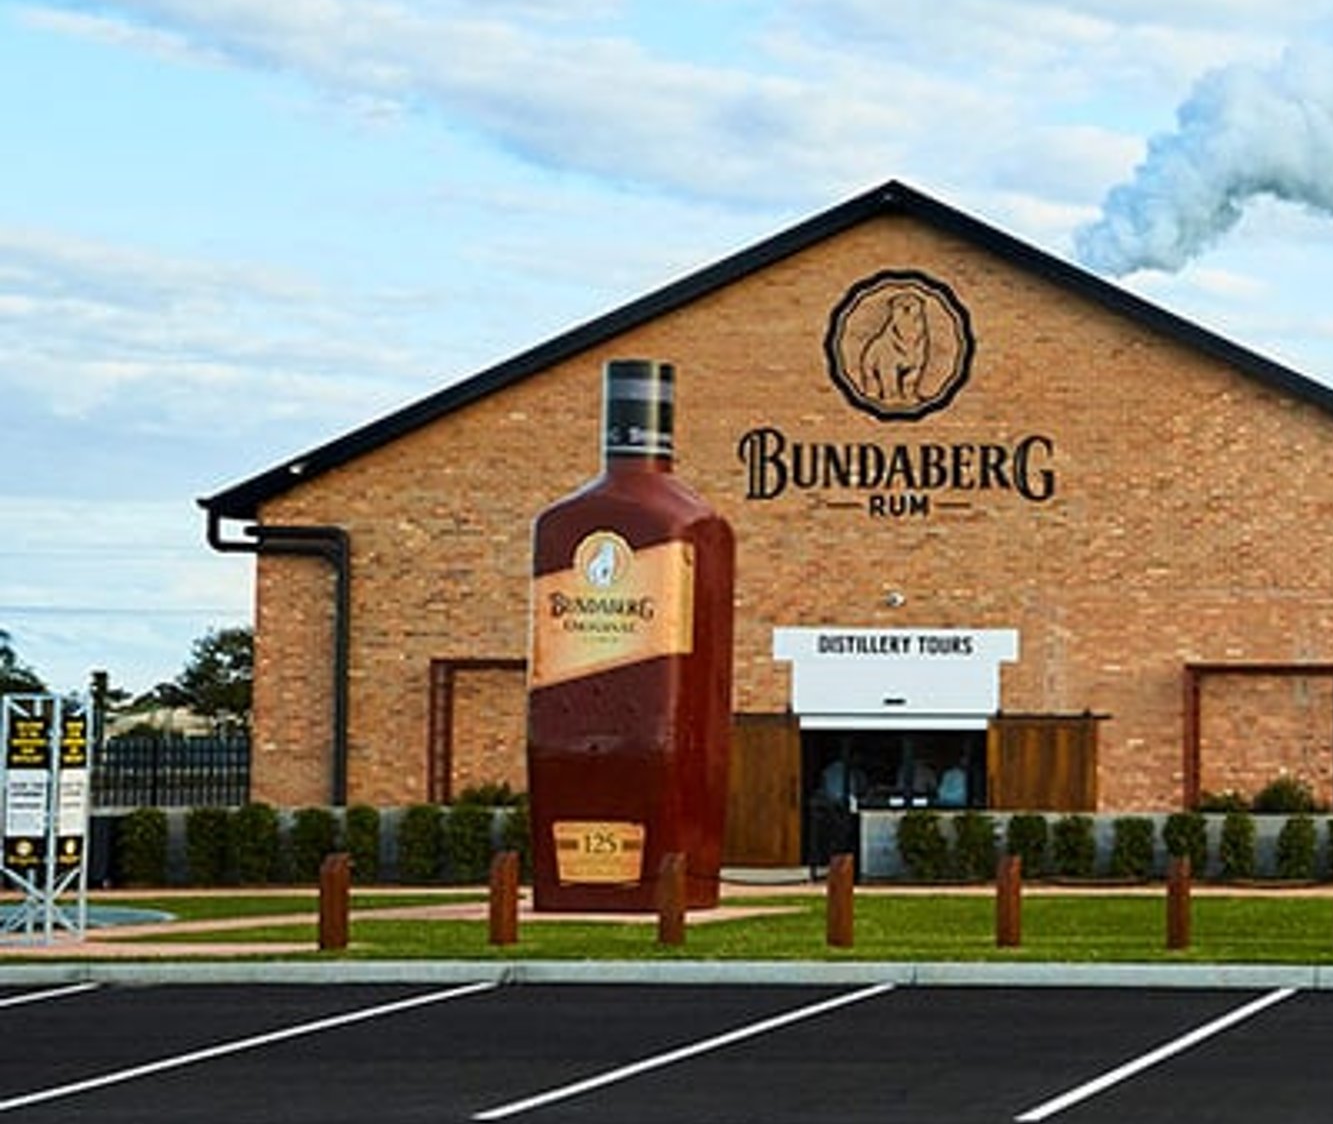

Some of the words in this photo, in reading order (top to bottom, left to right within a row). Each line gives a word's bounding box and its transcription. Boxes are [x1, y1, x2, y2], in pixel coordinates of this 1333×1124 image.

[738, 427, 1055, 502] BUNDABERG
[868, 494, 930, 518] RUM
[818, 634, 911, 654] DISTILLERY
[917, 634, 973, 654] TOURS
[585, 832, 617, 853] 125
